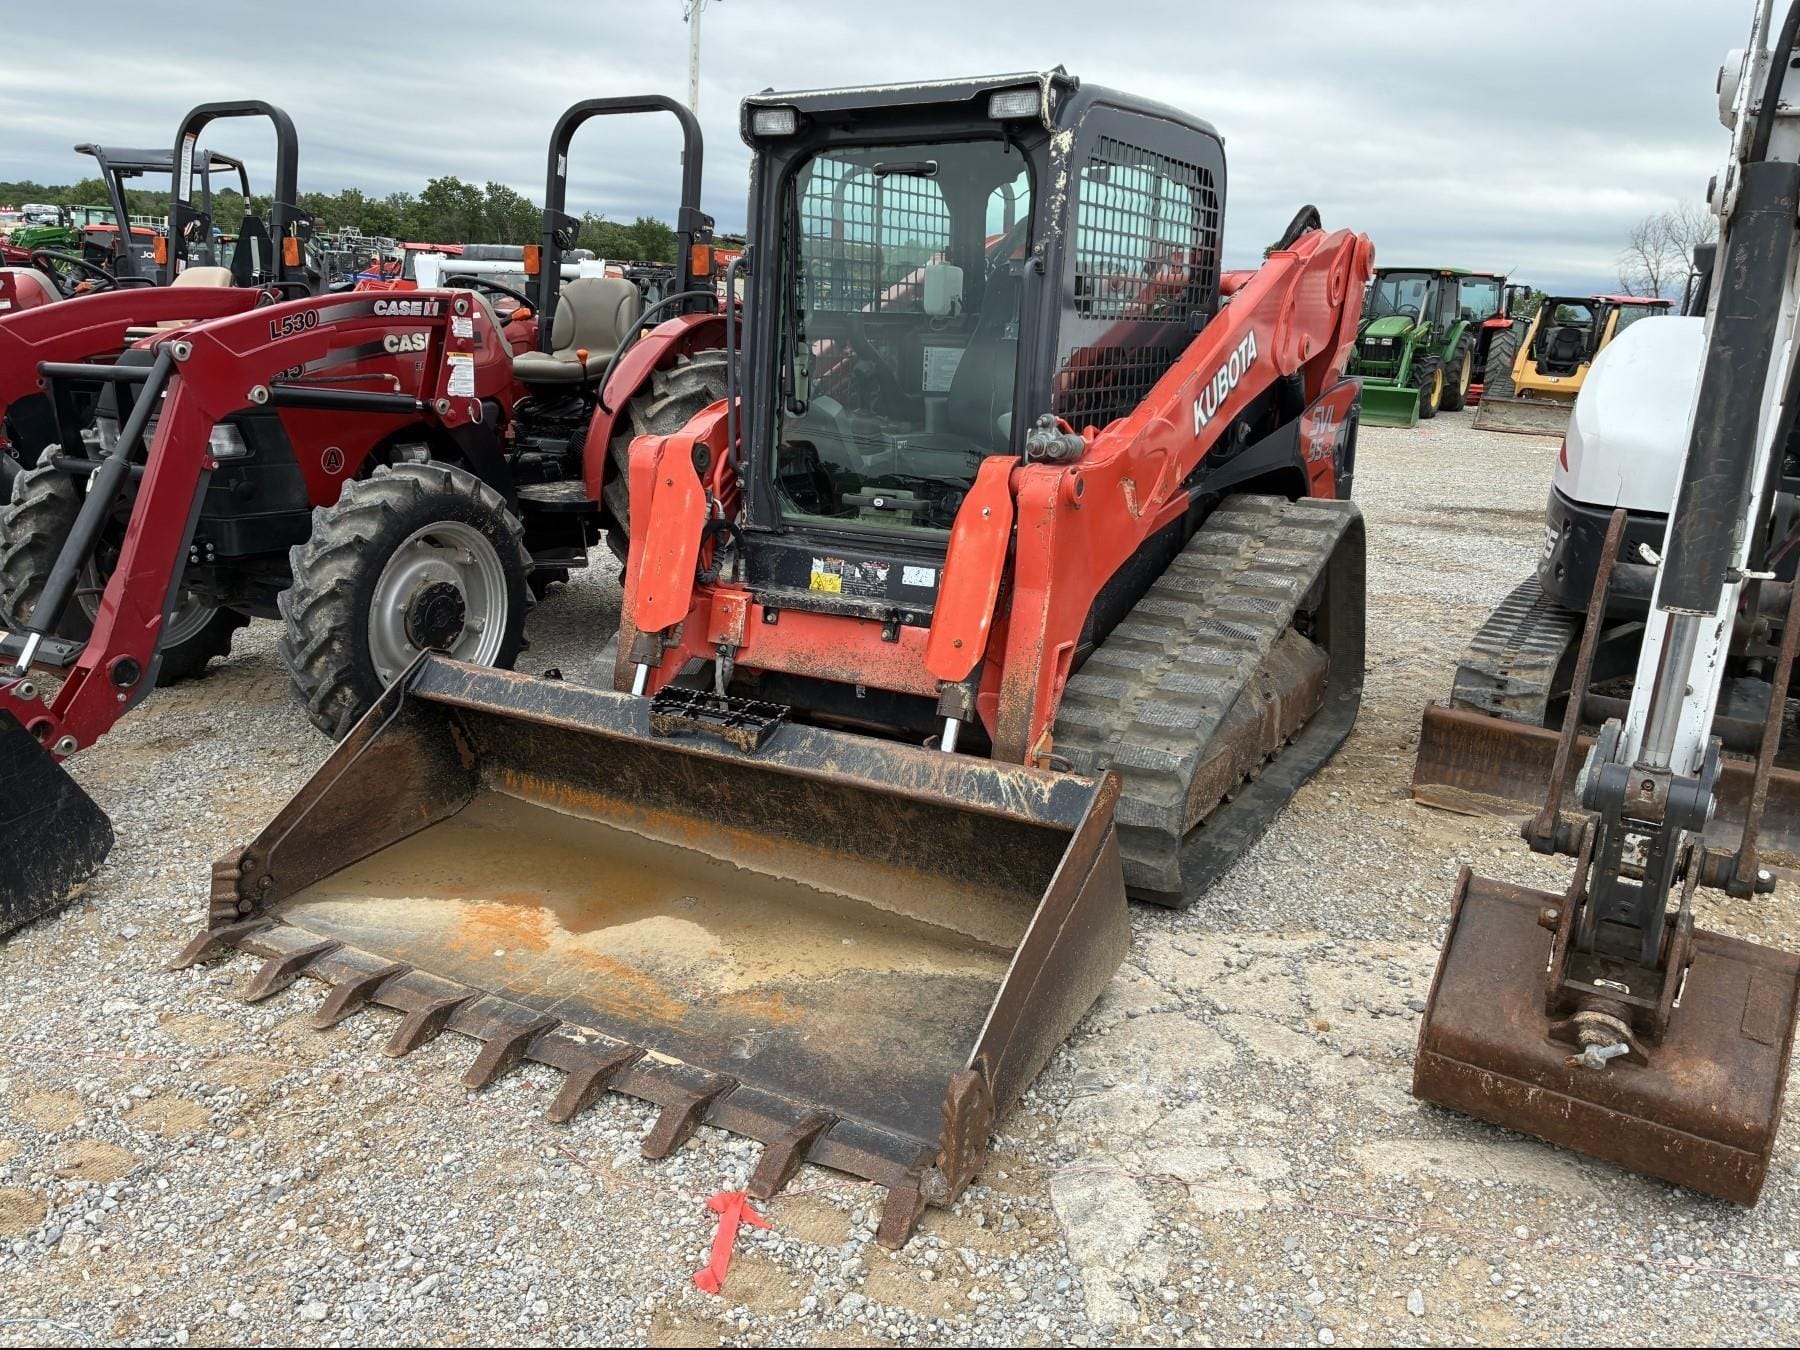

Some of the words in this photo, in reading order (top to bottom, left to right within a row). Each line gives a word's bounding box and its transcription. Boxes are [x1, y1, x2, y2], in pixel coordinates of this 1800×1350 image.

[374, 299, 423, 316] CASE
[270, 309, 319, 341] L530
[1193, 330, 1258, 436] KUBOTA
[1308, 404, 1337, 435] SVL
